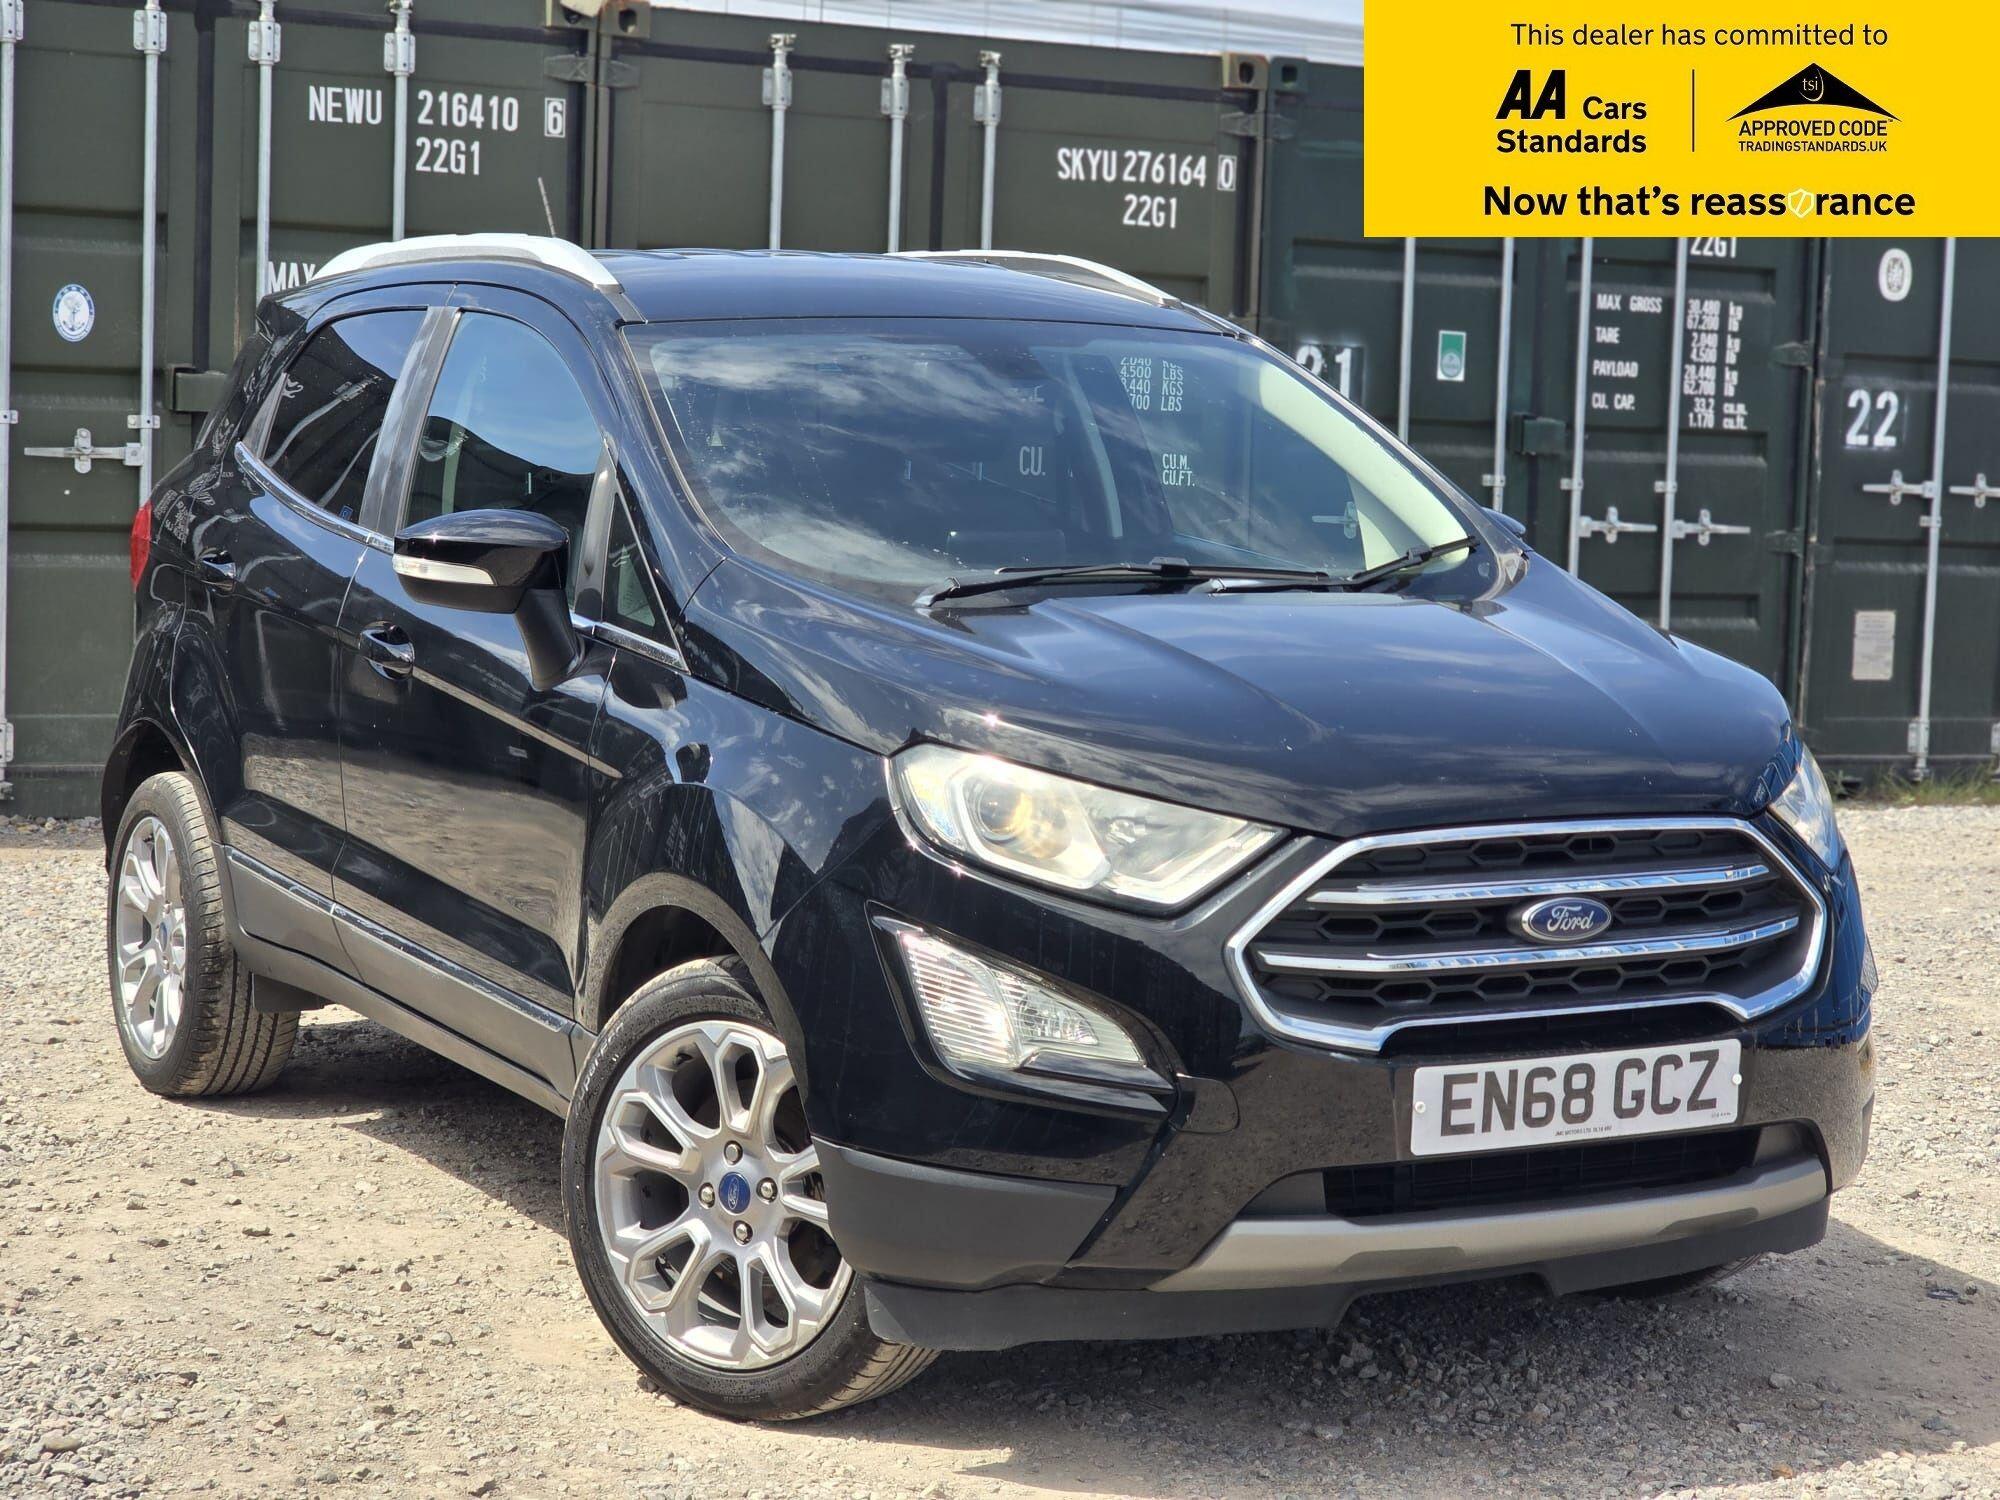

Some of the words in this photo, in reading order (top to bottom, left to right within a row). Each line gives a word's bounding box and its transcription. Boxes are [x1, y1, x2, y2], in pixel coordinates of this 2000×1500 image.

[308, 85, 382, 125] NEWU
[417, 89, 519, 132] 216410
[547, 101, 564, 135] 6
[415, 136, 480, 176] 22G1
[1057, 147, 1117, 182] SKYU
[1122, 150, 1207, 187] 276164
[1122, 193, 1177, 229] 22G1
[1596, 295, 1622, 311] MAX
[1629, 296, 1662, 313] GROSS
[1728, 301, 1743, 320] kg
[1595, 327, 1620, 344] TARE
[1726, 334, 1741, 353] kg
[1163, 368, 1184, 381] LBS
[1592, 359, 1639, 378] PAYLOAD
[1724, 366, 1739, 386] kg
[1162, 380, 1184, 396] KGS
[1161, 396, 1183, 412] LBS
[1845, 389, 1899, 447] 22
[1019, 446, 1046, 476] CU.
[1162, 453, 1190, 470] CU.M.
[1162, 469, 1196, 487] CU.FT.
[1546, 905, 1595, 932] Ford
[1440, 1062, 1596, 1137] EN68
[1613, 1049, 1720, 1119] GCZ
